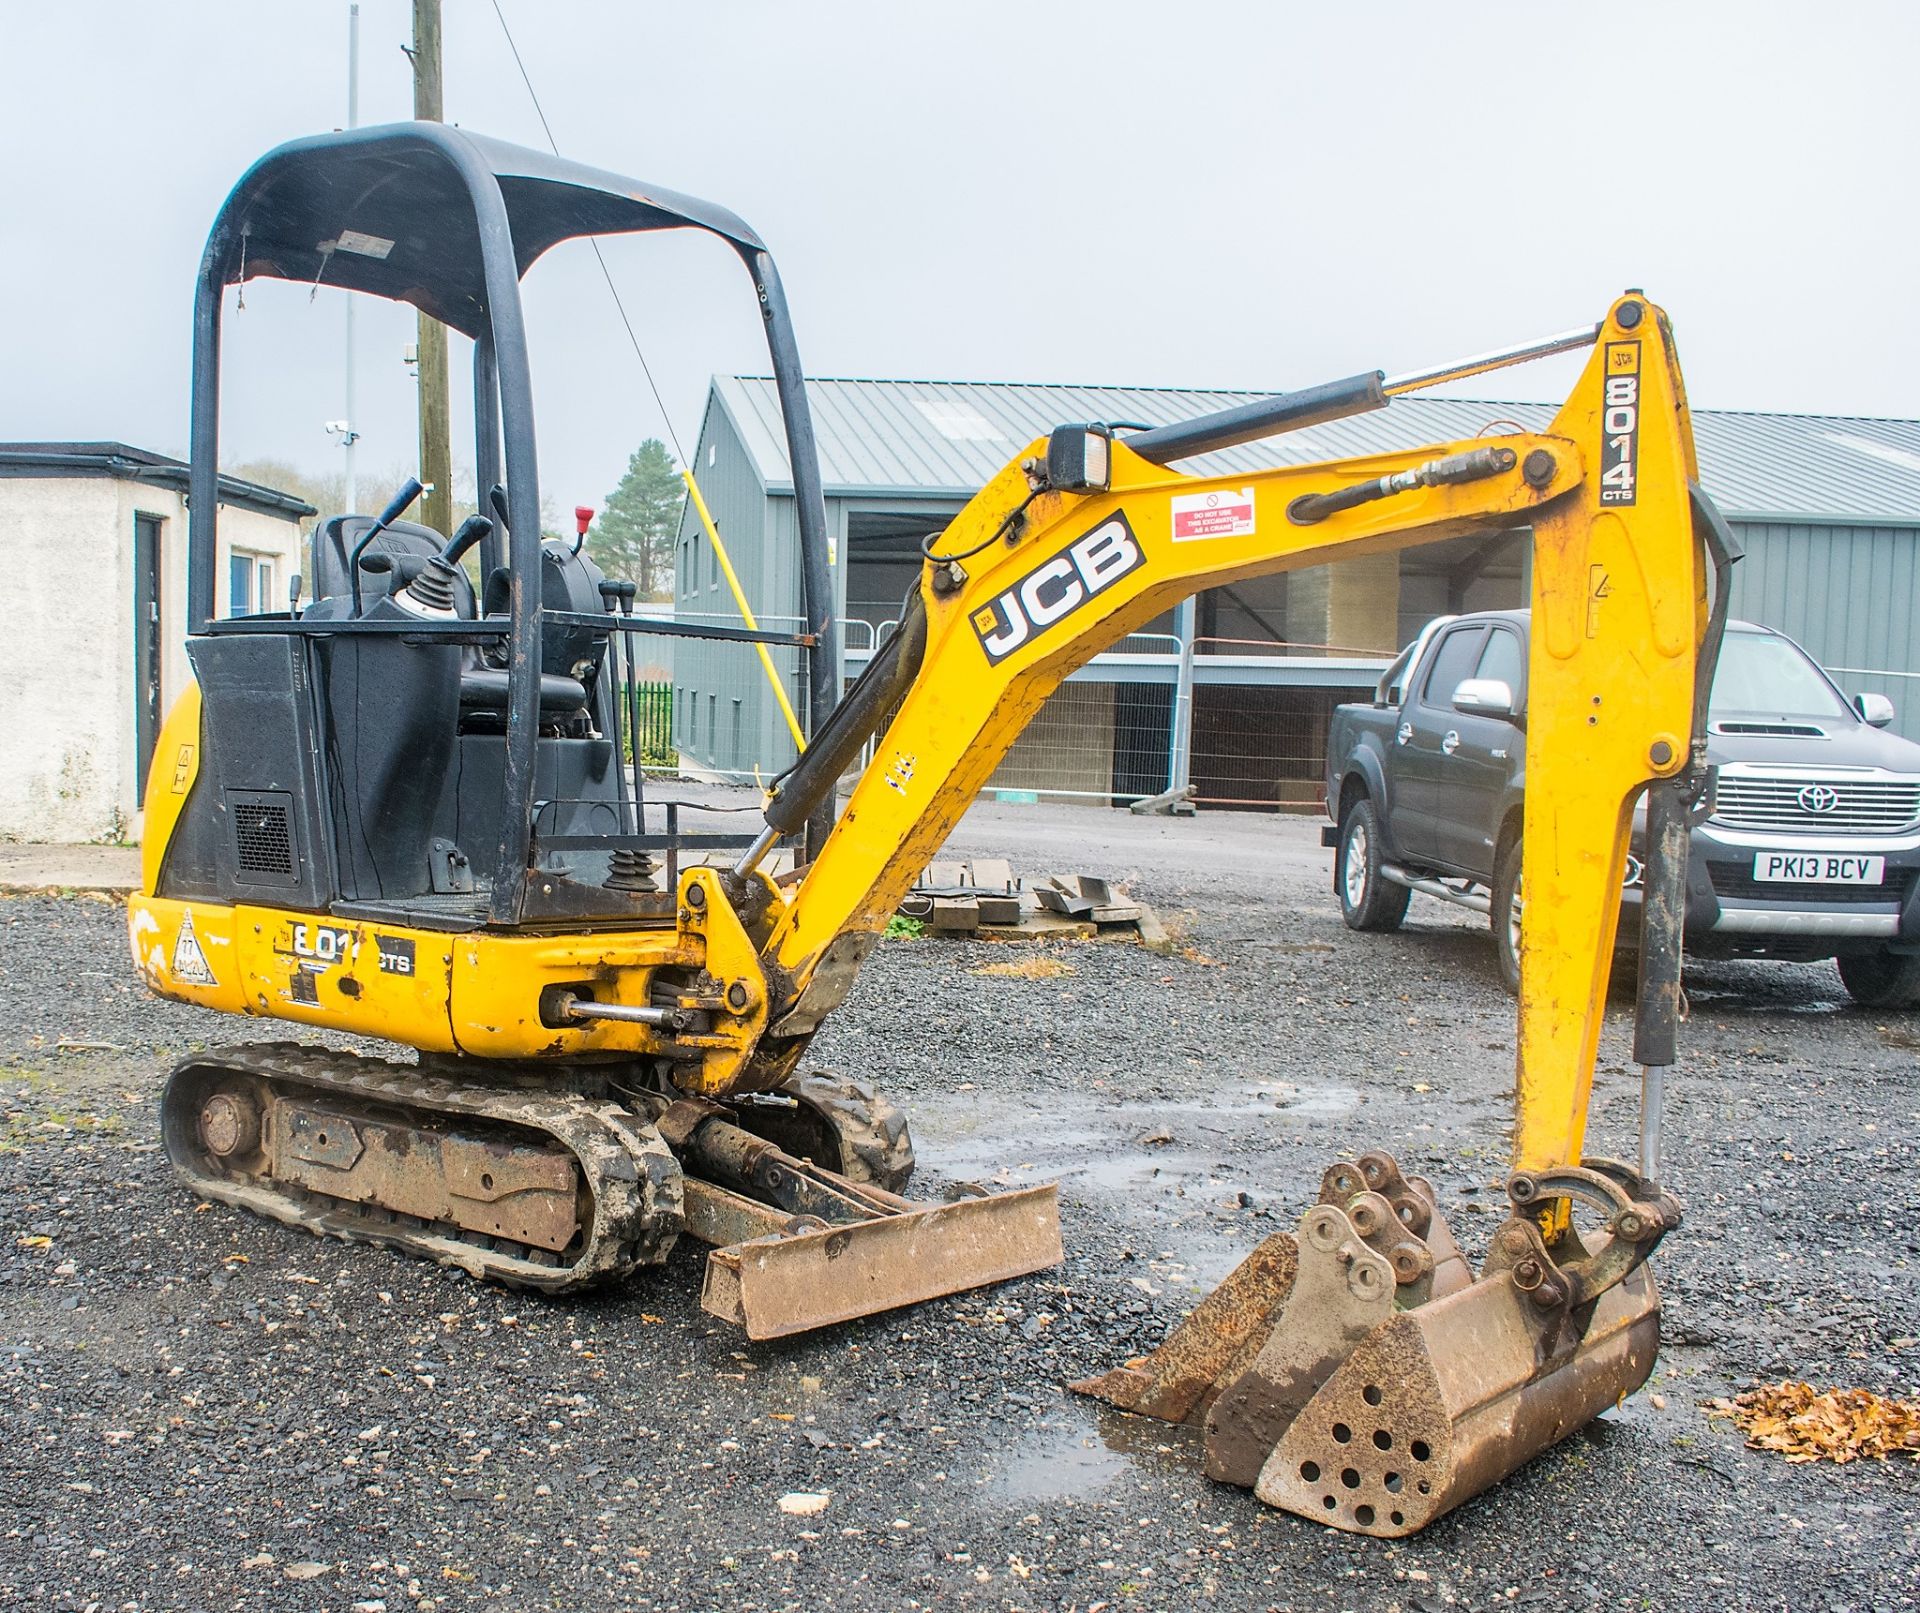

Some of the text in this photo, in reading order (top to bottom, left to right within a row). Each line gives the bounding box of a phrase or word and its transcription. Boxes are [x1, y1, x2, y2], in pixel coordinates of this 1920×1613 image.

[1614, 352, 1633, 367] JCB
[1602, 377, 1637, 490] 8014
[1602, 490, 1633, 501] CTS
[1194, 512, 1203, 520] DO
[1205, 510, 1218, 518] NOT
[1187, 519, 1202, 527] THIS
[1210, 524, 1232, 532] CRANE
[983, 520, 1139, 657] JCB
[1768, 857, 1870, 880] PK13 BCV
[294, 925, 361, 960] 801
